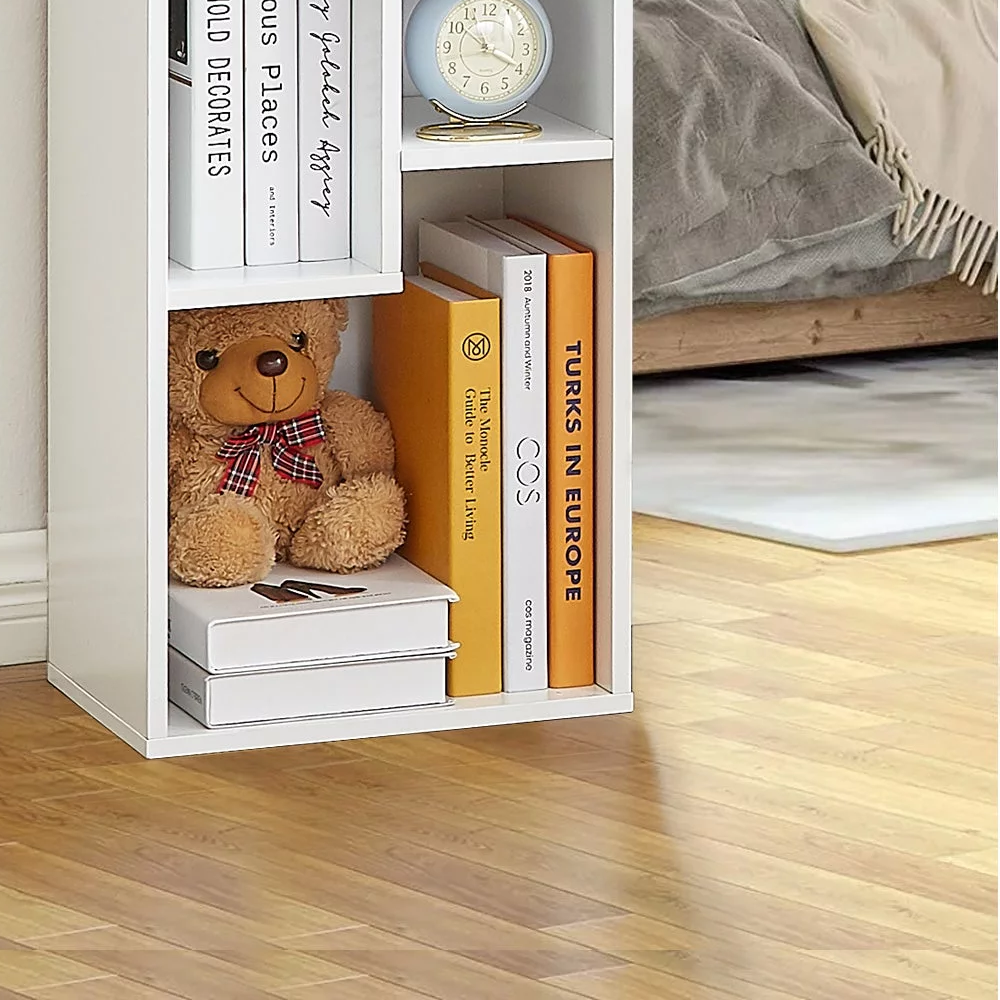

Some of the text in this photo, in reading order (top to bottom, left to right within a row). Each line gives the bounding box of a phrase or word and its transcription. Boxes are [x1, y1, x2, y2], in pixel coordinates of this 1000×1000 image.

[482, 3, 497, 16] 12
[449, 21, 464, 34] 10
[517, 23, 524, 36] 2
[442, 41, 452, 54] 9
[522, 43, 530, 56] 3
[447, 62, 456, 75] 8
[514, 63, 523, 75] 4
[462, 75, 471, 88] 7
[480, 82, 489, 94] 6
[501, 77, 509, 90] 5
[208, 58, 231, 176] DECORATES
[262, 65, 282, 162] Places
[523, 270, 533, 292] 2018
[524, 340, 532, 359] and
[524, 360, 532, 390] Winter
[480, 387, 491, 471] The Monocle
[462, 389, 476, 540] Guide to Better Living
[517, 437, 540, 505] COS
[566, 340, 581, 601] TURKS IN EUROPE
[523, 600, 534, 671] cos magazine
